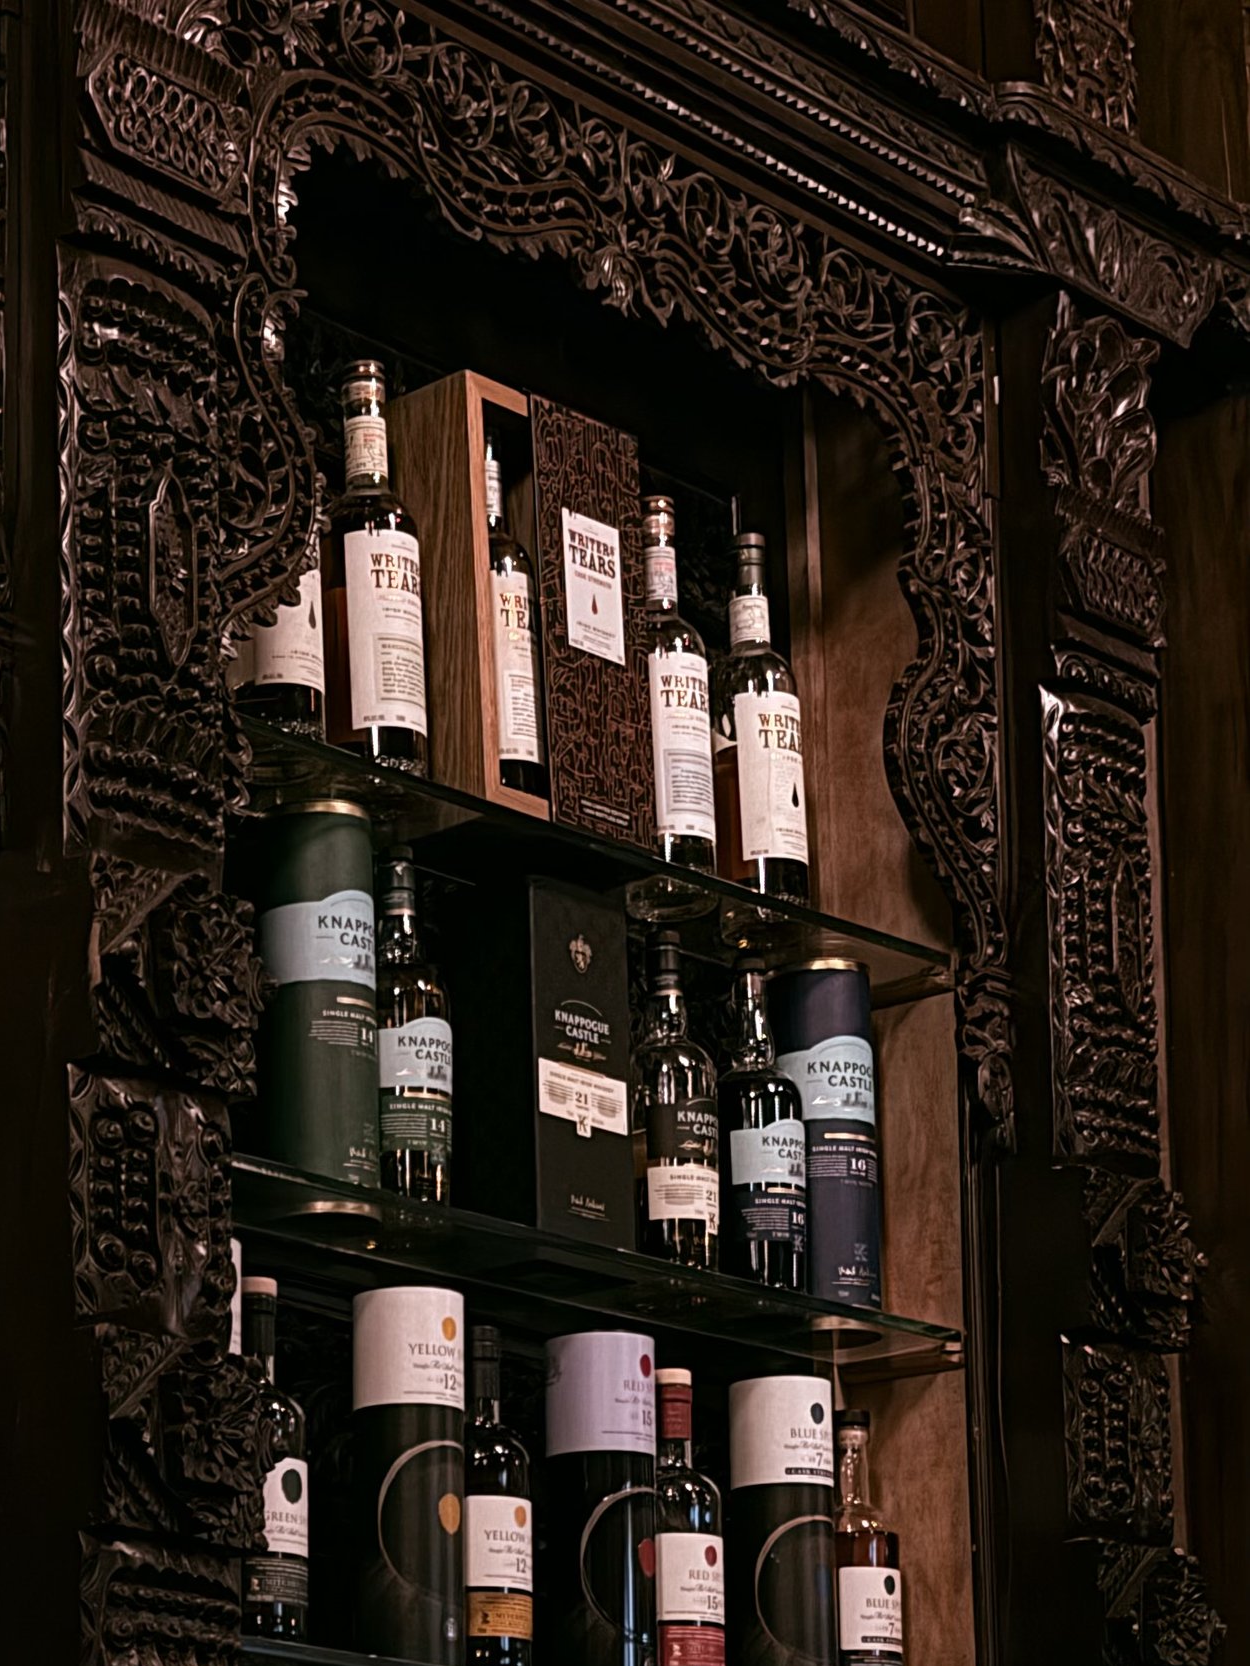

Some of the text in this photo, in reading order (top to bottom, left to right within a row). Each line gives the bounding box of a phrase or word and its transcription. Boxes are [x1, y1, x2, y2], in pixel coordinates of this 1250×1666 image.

[568, 544, 616, 579] TEARS
[554, 1009, 610, 1036] KNAPPOGUE
[565, 1025, 600, 1045] CASTLE
[574, 1091, 589, 1106] 21
[430, 1118, 446, 1134] 14
[849, 1157, 867, 1172] 16
[408, 1342, 456, 1358] YELLOW
[443, 1373, 457, 1392] 12
[623, 1379, 645, 1393] RED
[642, 1409, 653, 1427] 15
[790, 1427, 817, 1440] BLUE
[815, 1452, 823, 1468] 7
[484, 1529, 525, 1543] YELLOW
[516, 1557, 527, 1574] 12
[688, 1569, 710, 1581] RED
[707, 1594, 719, 1611] 15
[866, 1597, 890, 1610] BLUE
[888, 1622, 896, 1636] 7
